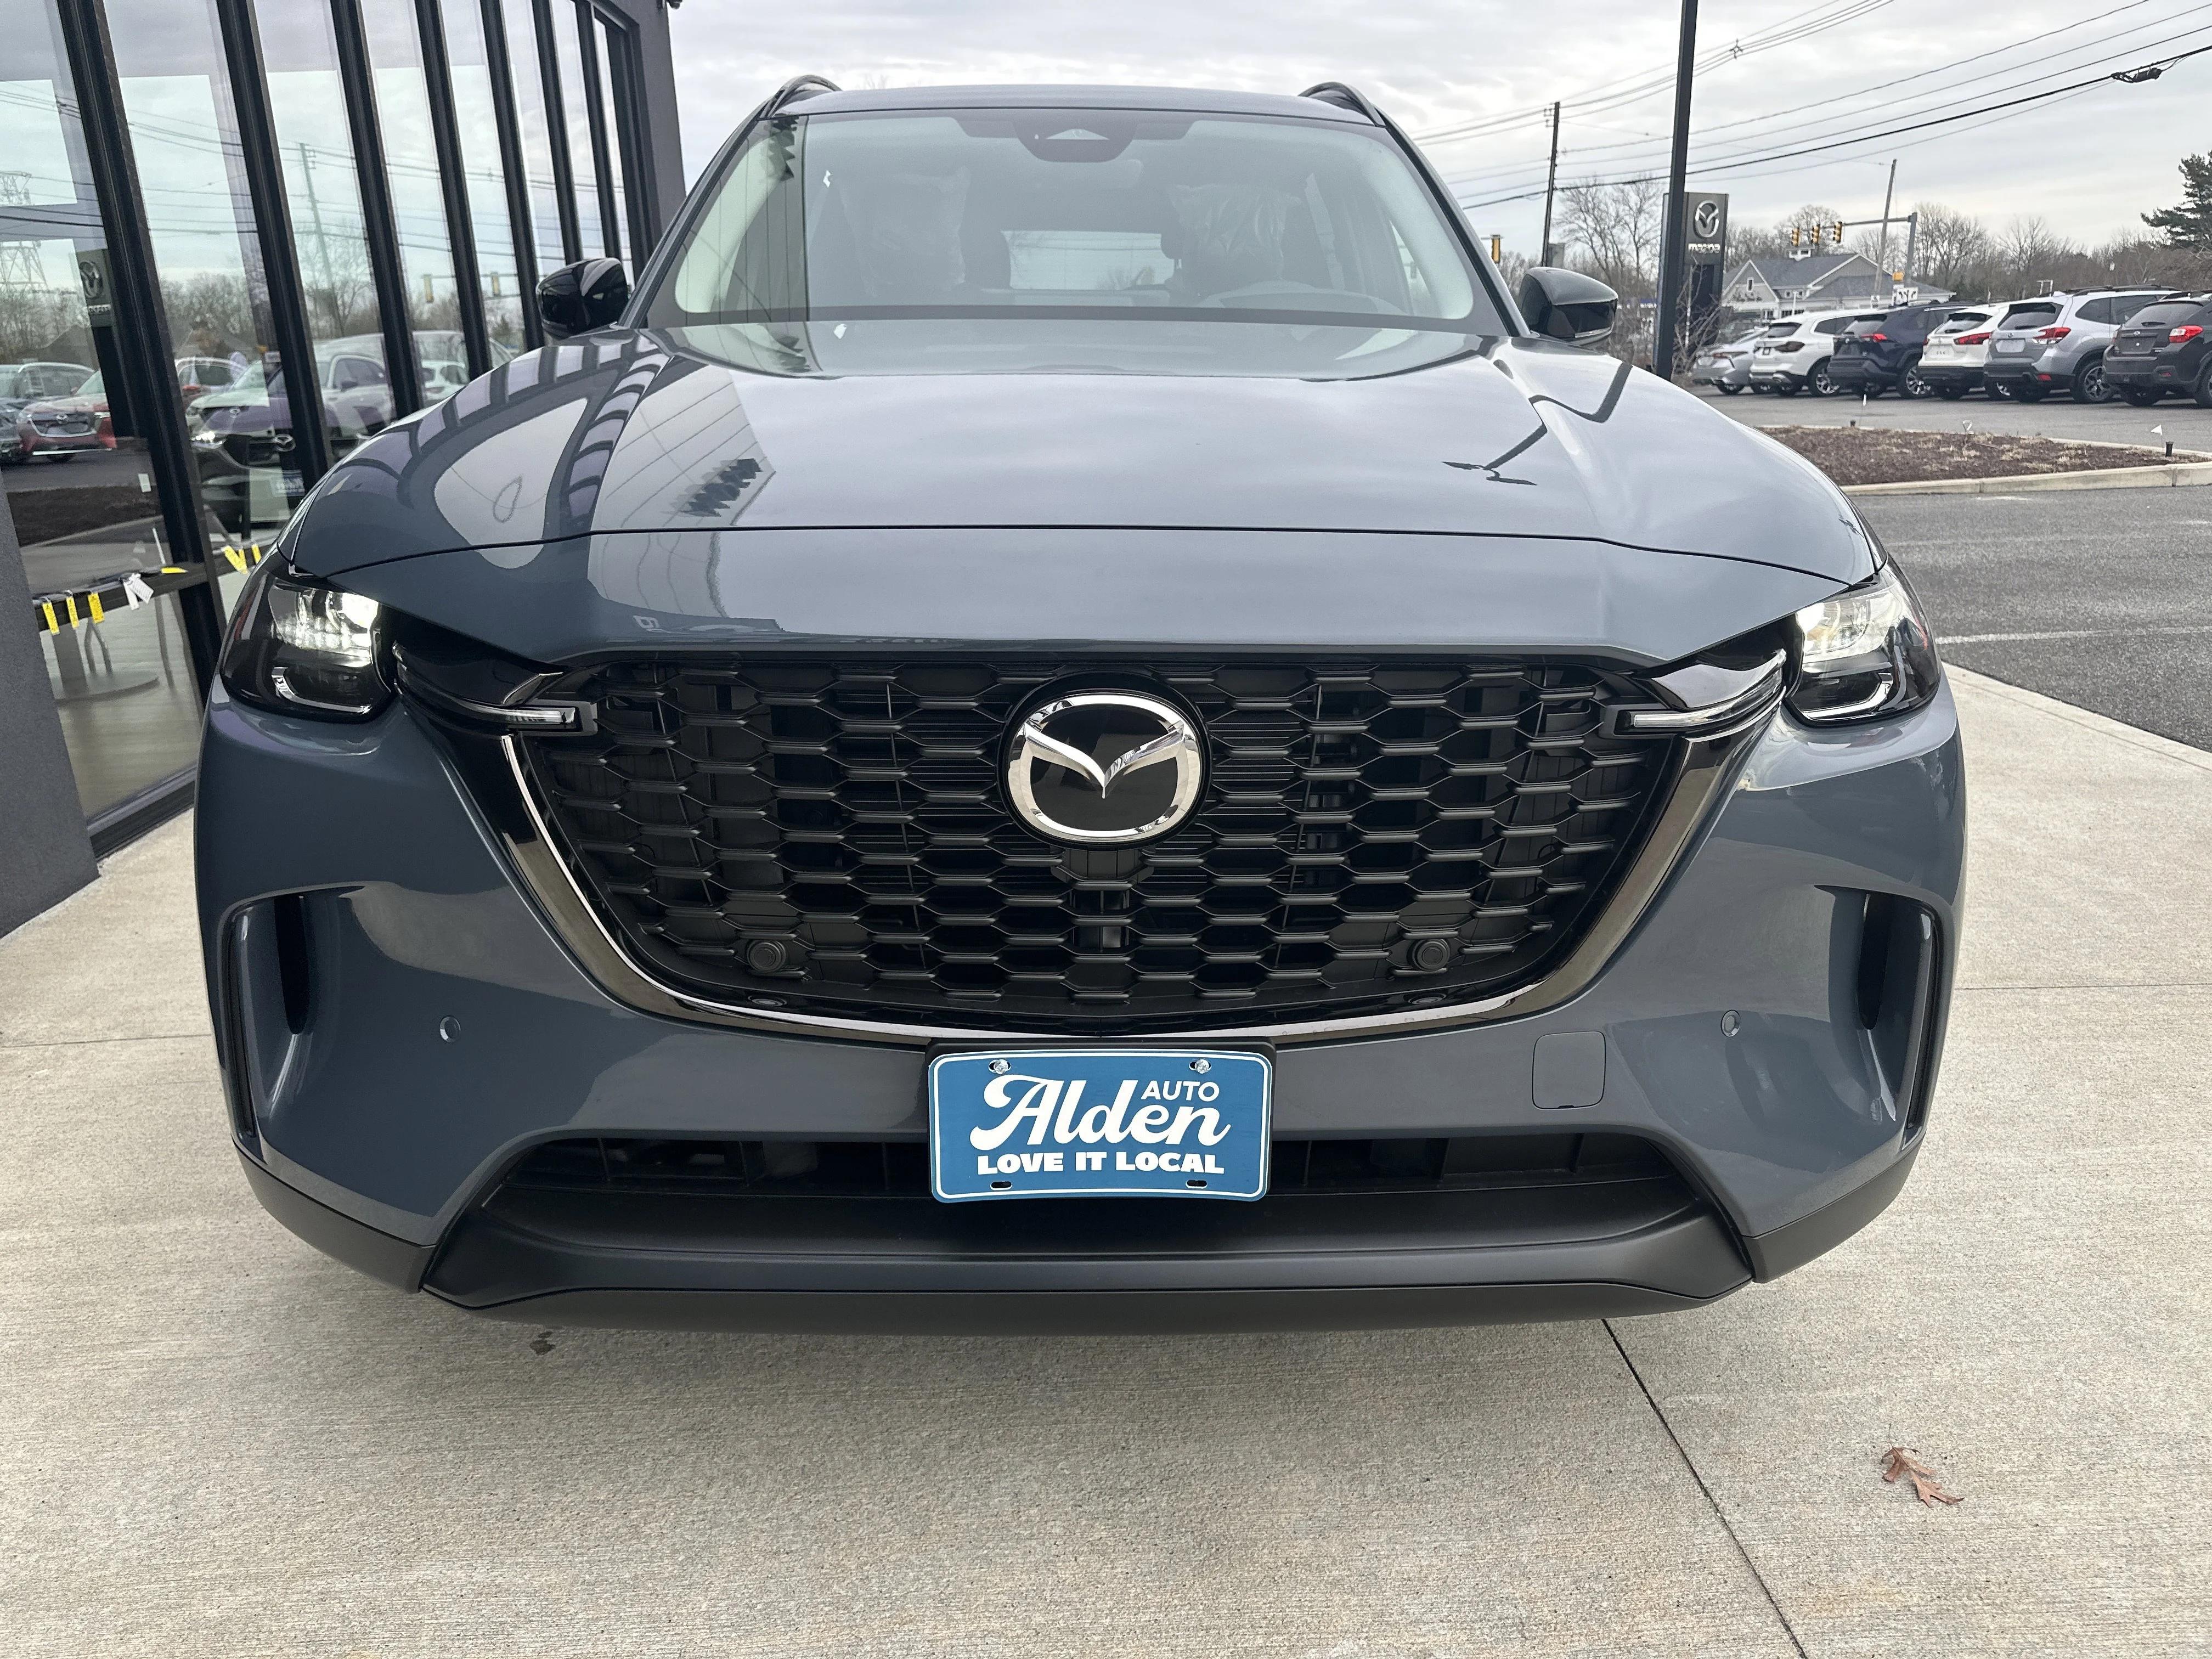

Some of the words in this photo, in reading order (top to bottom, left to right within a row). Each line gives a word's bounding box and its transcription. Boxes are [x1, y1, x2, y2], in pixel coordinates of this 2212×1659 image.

[1141, 1080, 1220, 1102] AUTO
[969, 1074, 1231, 1150] Alden
[977, 1152, 1064, 1175] LOVE
[1075, 1152, 1107, 1171] IT
[1115, 1152, 1224, 1174] LOCAL
